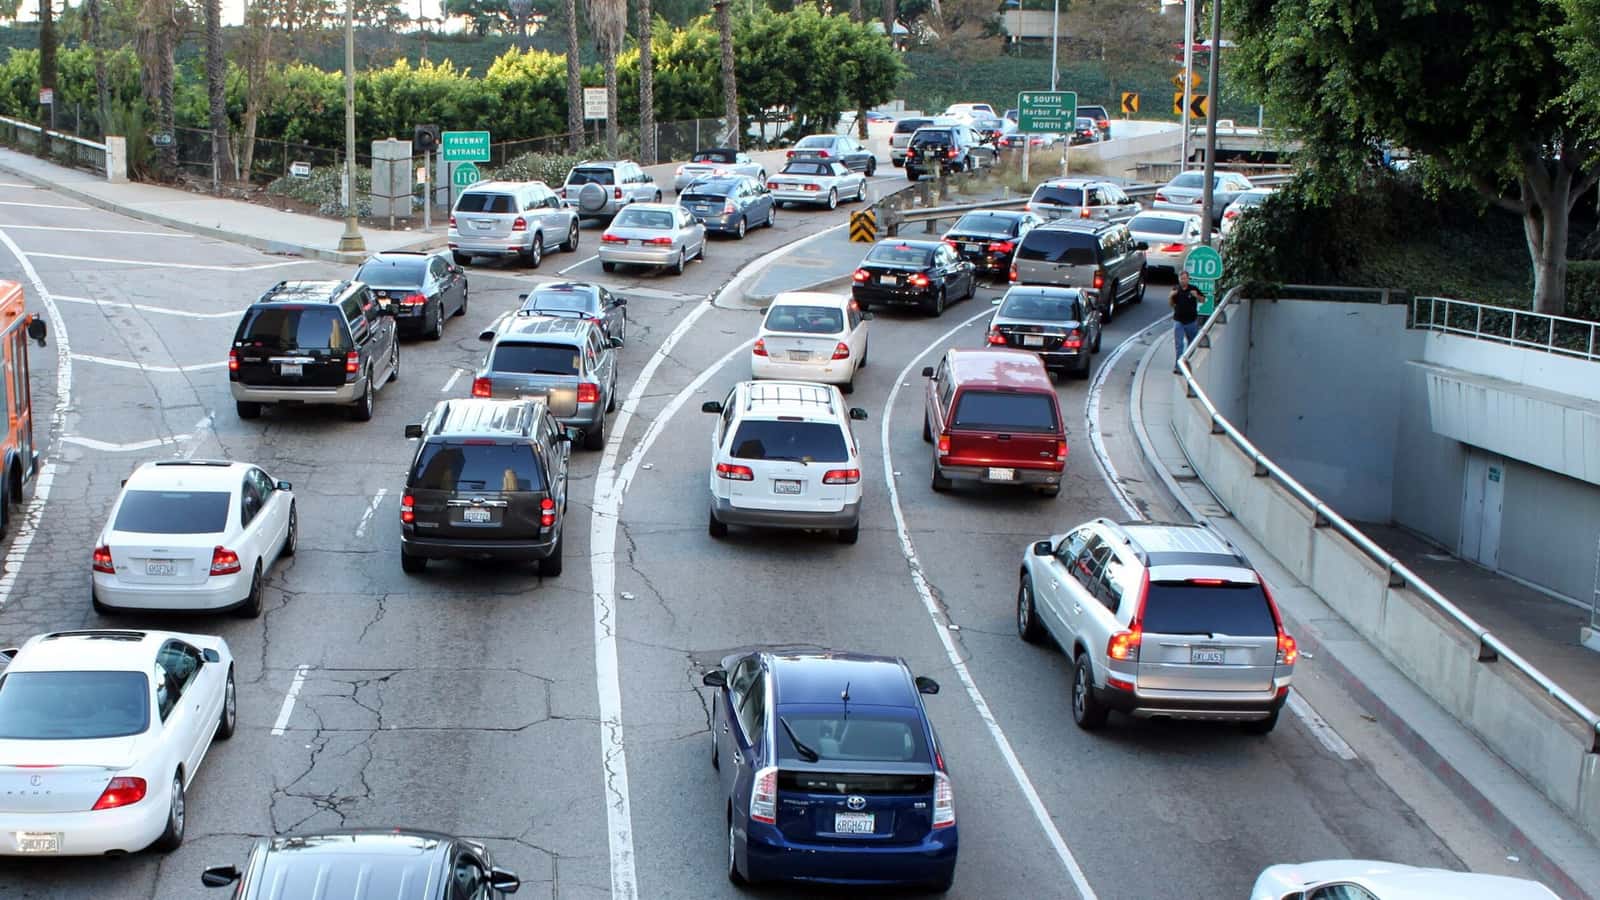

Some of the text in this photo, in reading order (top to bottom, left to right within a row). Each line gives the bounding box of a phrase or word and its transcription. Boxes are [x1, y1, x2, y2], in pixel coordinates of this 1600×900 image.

[1033, 95, 1062, 103] SOUTH
[1022, 108, 1073, 118] Harbor Fwy
[1032, 121, 1062, 129] NORTH
[449, 137, 484, 145] FREEWAY
[446, 148, 486, 156] ENTRANCE
[456, 172, 478, 184] 110
[1190, 259, 1216, 275] 110
